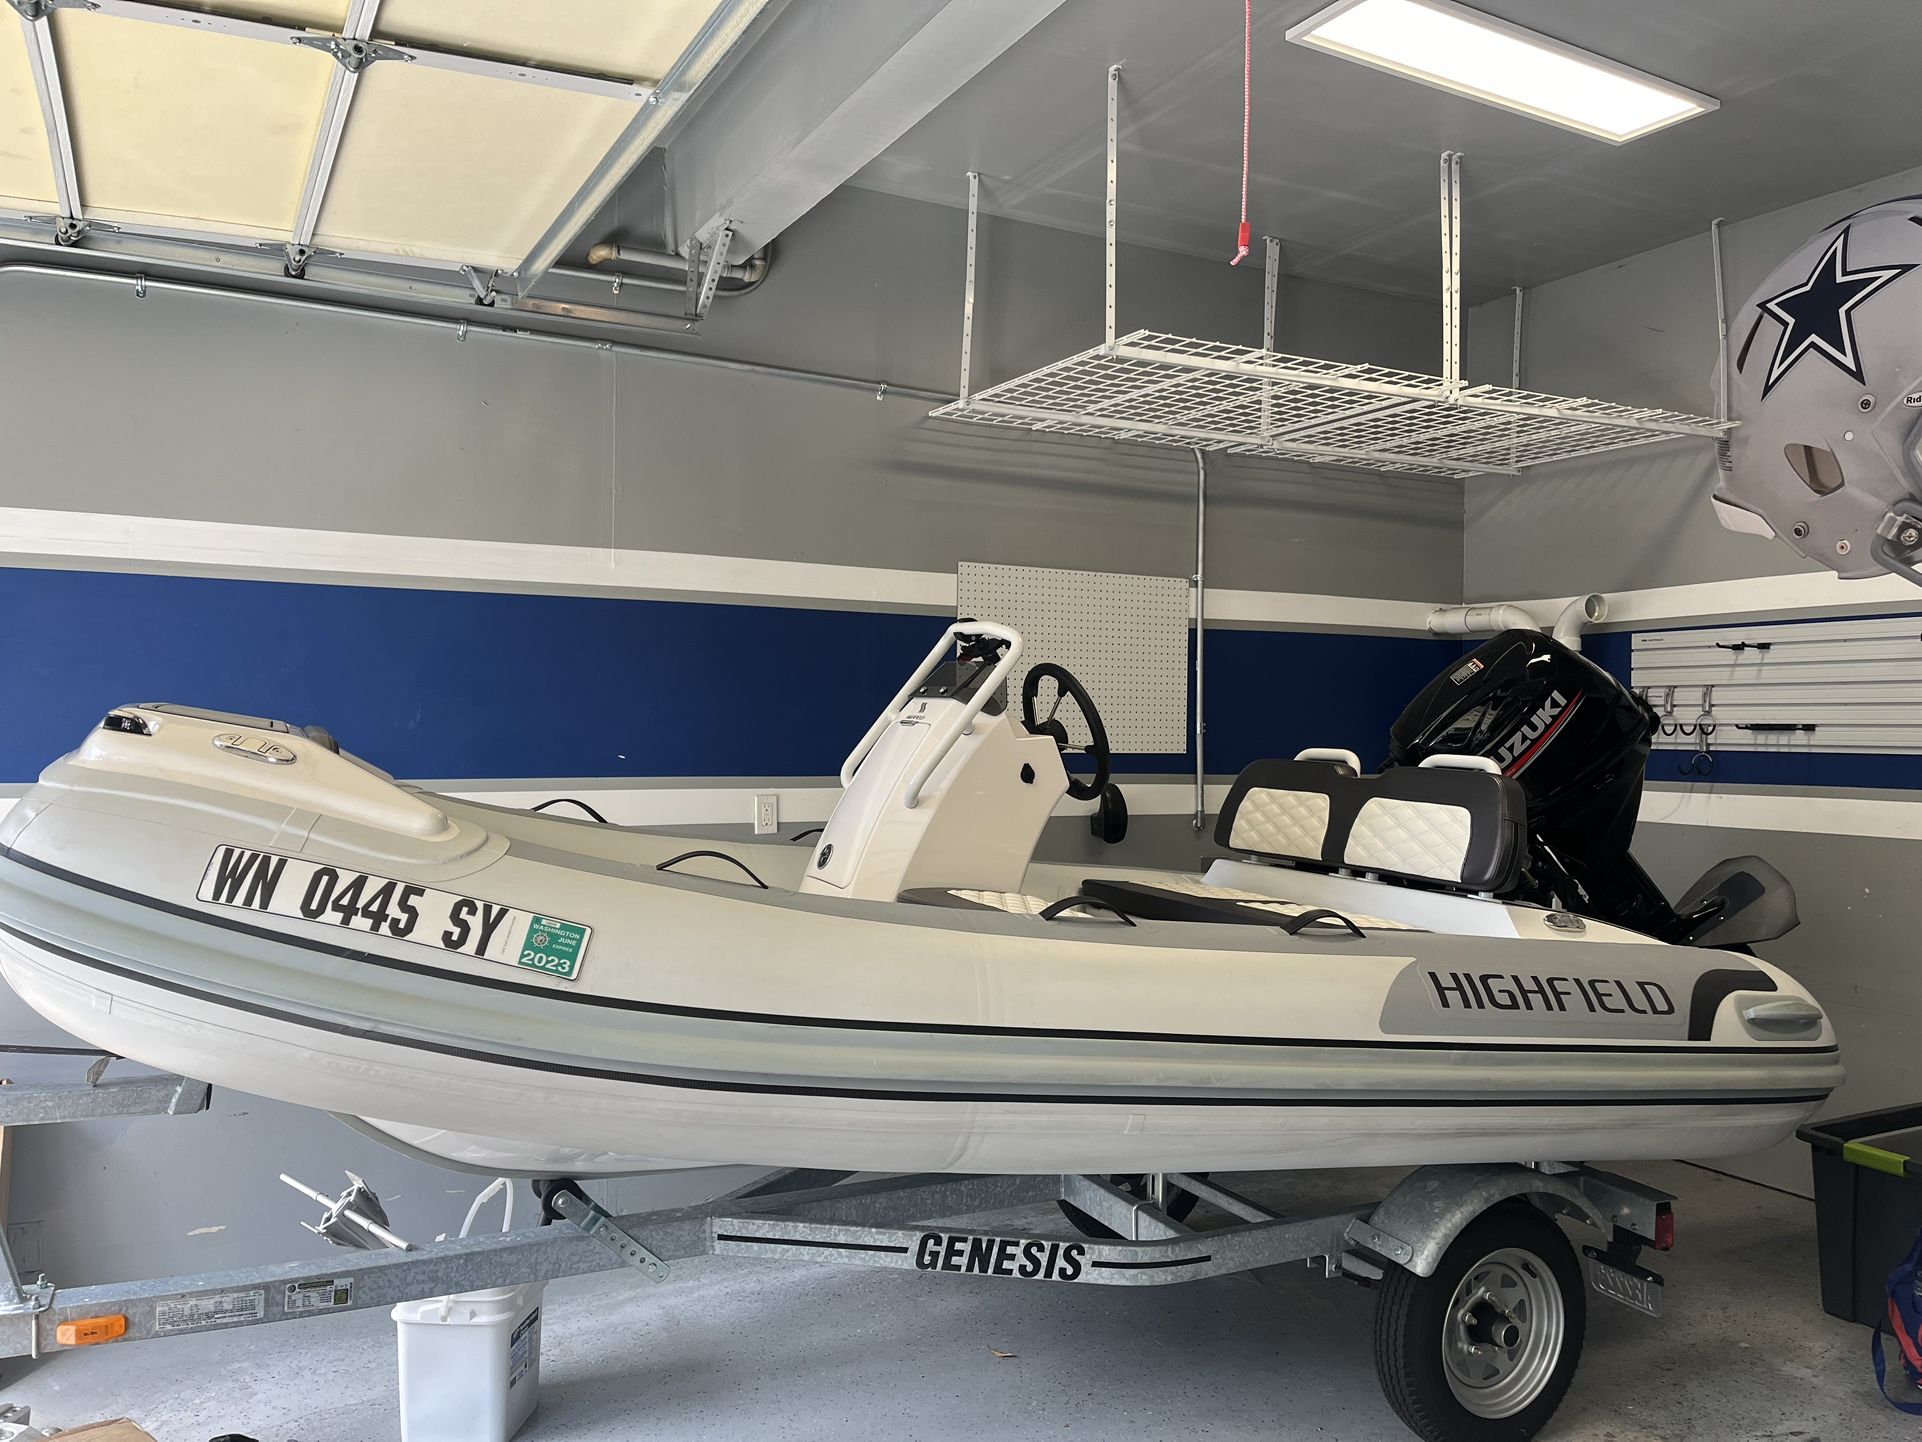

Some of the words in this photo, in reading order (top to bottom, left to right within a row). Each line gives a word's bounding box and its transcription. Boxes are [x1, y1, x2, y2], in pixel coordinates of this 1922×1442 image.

[1906, 395, 1921, 404] Rid
[1490, 690, 1567, 769] UZUKI
[211, 847, 288, 911] WN
[300, 866, 427, 939] 0445
[441, 898, 510, 957] SY
[533, 923, 580, 940] WASHINGTON
[557, 937, 577, 946] JUNE
[520, 950, 571, 972] 2023
[1427, 971, 1675, 1016] HIGHFIELD
[915, 1232, 1086, 1281] GENESIS
